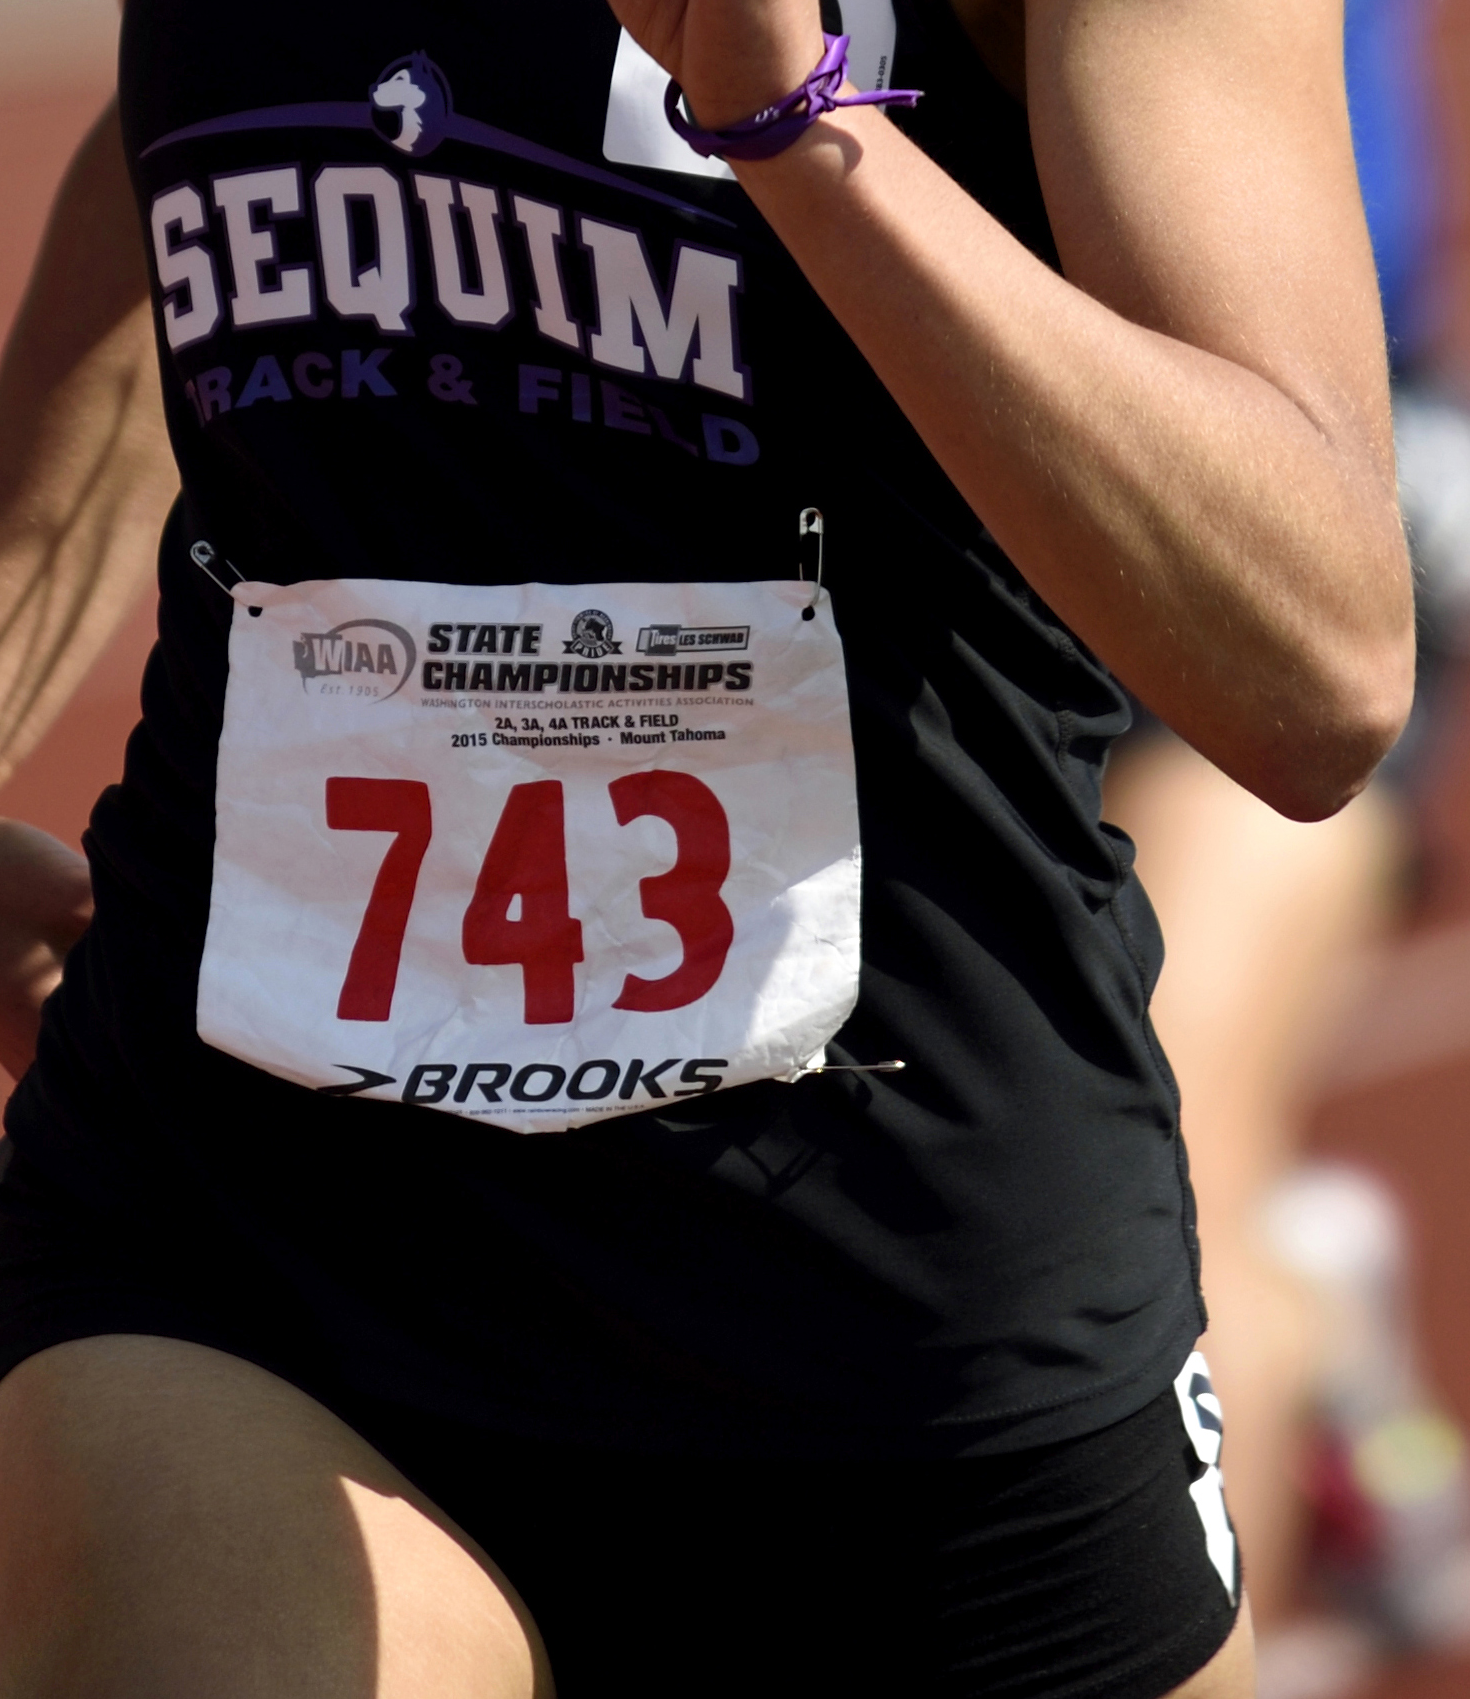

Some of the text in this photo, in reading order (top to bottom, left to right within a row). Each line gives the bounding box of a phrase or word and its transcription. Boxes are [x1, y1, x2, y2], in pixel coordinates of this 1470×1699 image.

[150, 163, 752, 402] SEQUIM
[427, 353, 478, 405] &
[518, 364, 760, 466] FIELD
[427, 622, 542, 657] STATE
[574, 640, 612, 658] PRIDE
[650, 629, 744, 648] Tires LES SCHWAB
[312, 636, 398, 675] WIAA
[349, 685, 379, 697] 1905
[421, 660, 753, 693] CHAMPIONSHIPS
[421, 696, 754, 710] WASHINGTON INTERSCHOLASTIC ACTIVITIES ASSOCIATION
[451, 728, 726, 749] 2015 Championships Mount Tahoma
[495, 714, 679, 733] 2A, 3A, 4A TRACK & FIELD
[325, 769, 735, 1026] 743
[401, 1058, 729, 1104] BROOKS
